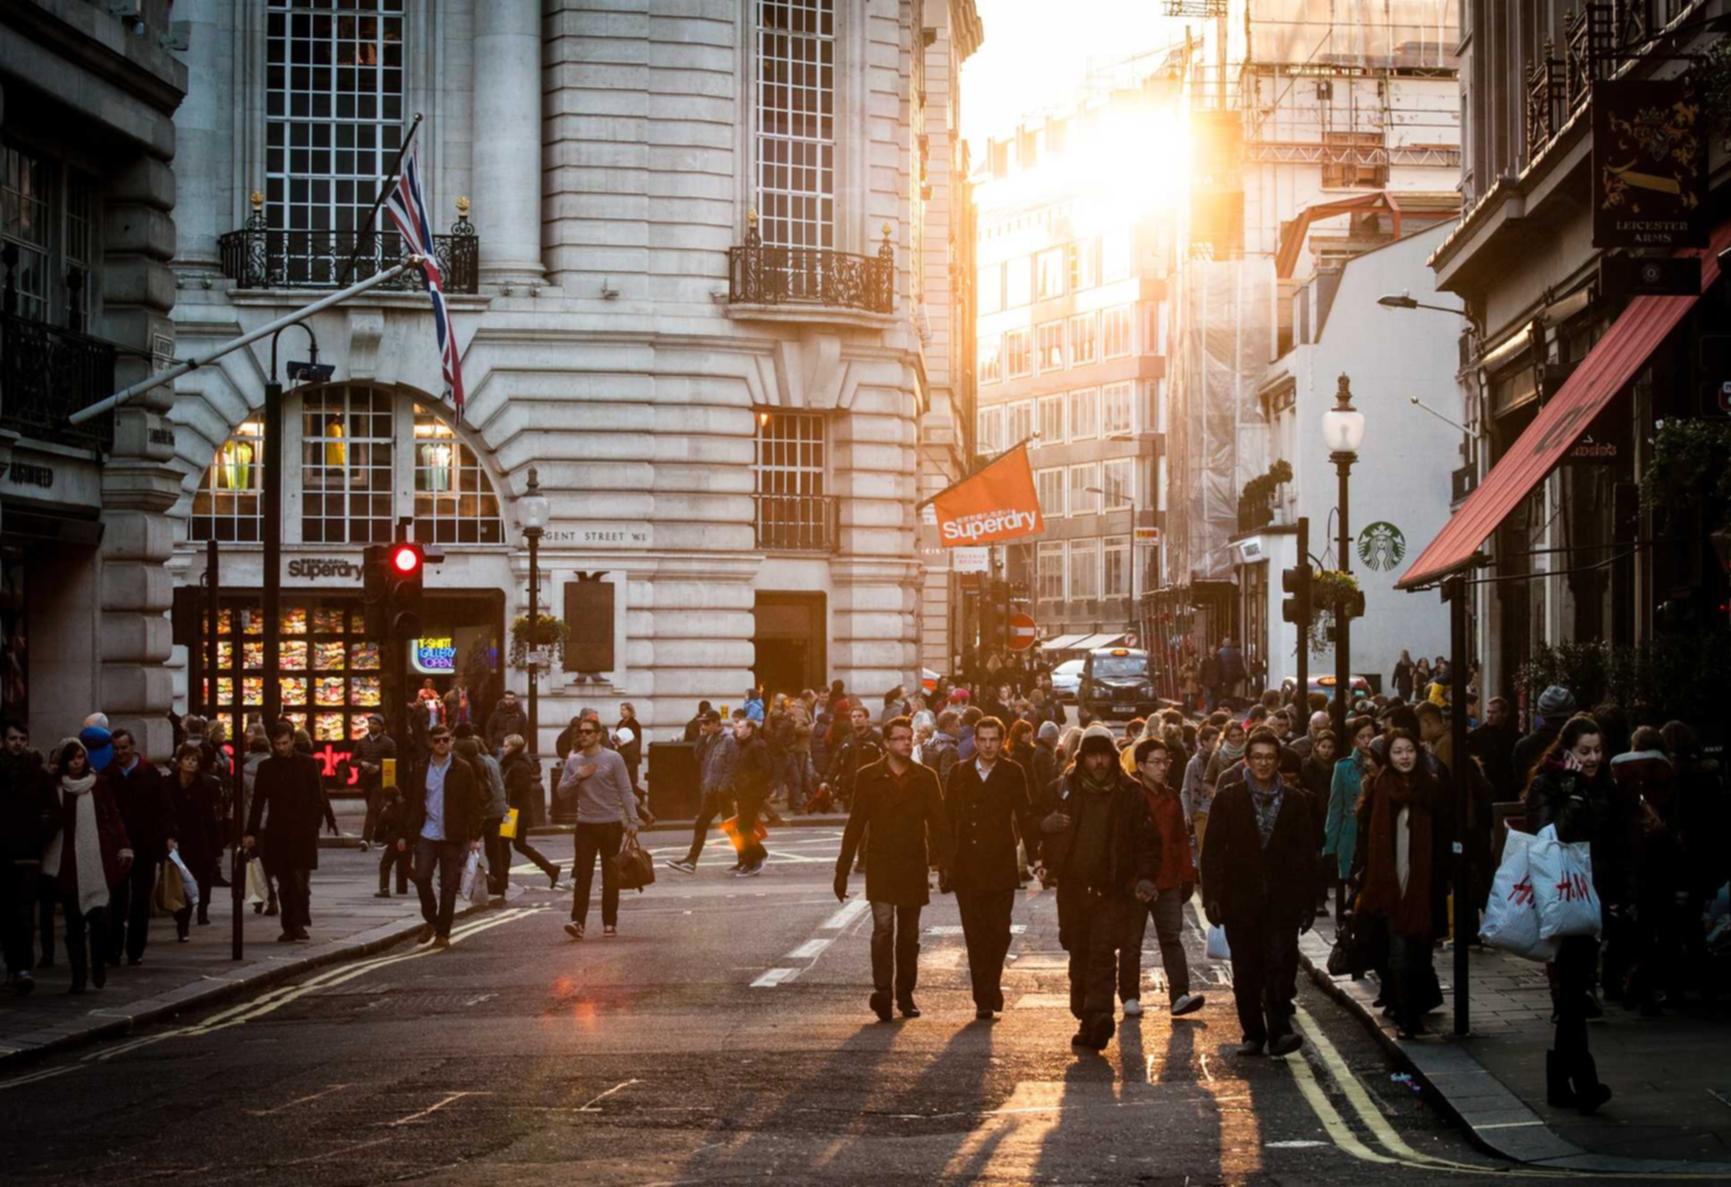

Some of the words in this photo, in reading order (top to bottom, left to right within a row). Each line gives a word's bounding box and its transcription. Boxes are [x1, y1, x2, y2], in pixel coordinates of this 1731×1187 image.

[1615, 219, 1688, 231] LEICESTER
[1634, 232, 1673, 243] ARMS
[942, 509, 1037, 540] Superdry
[584, 531, 626, 542] STREET
[289, 560, 364, 581] Superdry
